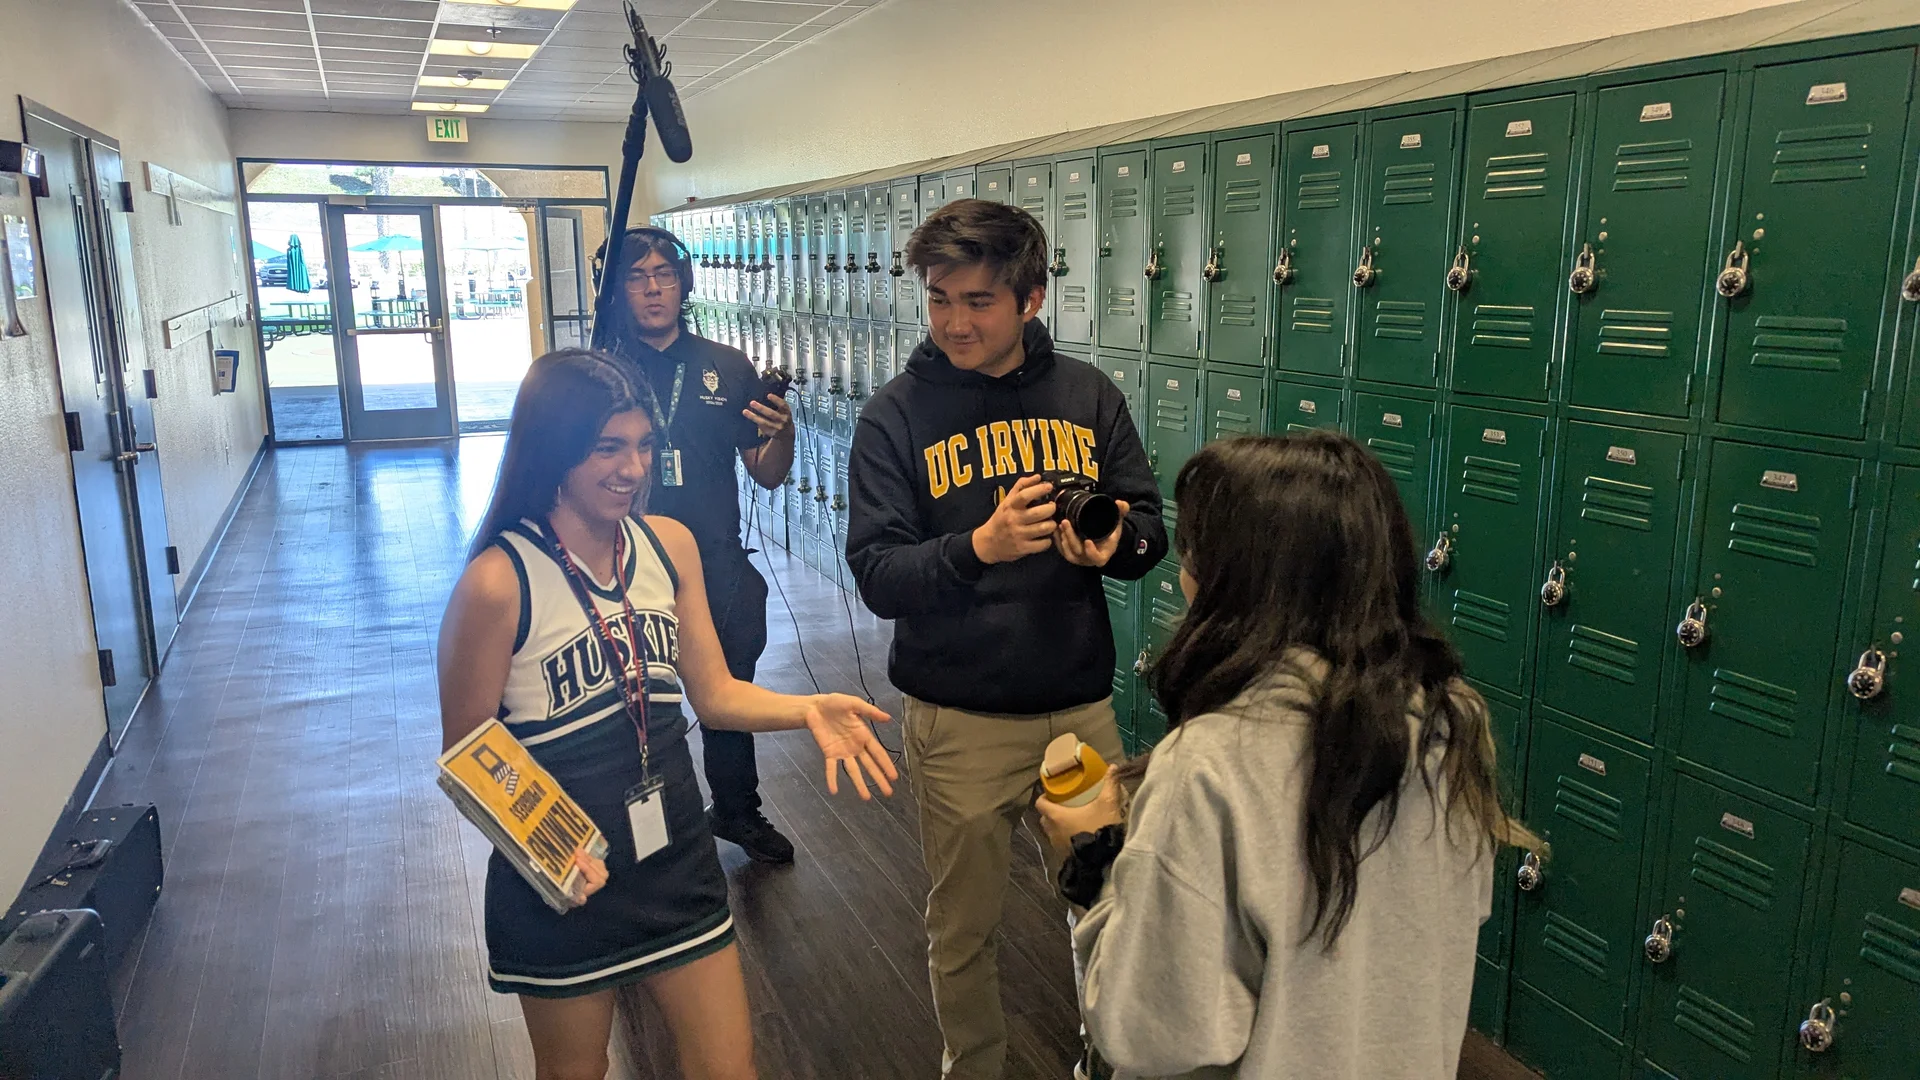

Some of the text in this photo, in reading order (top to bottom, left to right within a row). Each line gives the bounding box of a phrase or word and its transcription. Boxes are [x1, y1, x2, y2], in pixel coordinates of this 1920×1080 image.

[435, 118, 460, 138] EXIT
[924, 418, 1099, 499] UC IRVINE
[1771, 474, 1786, 483] 347
[509, 785, 543, 824] PROGRESS
[525, 795, 590, 876] FILMING
